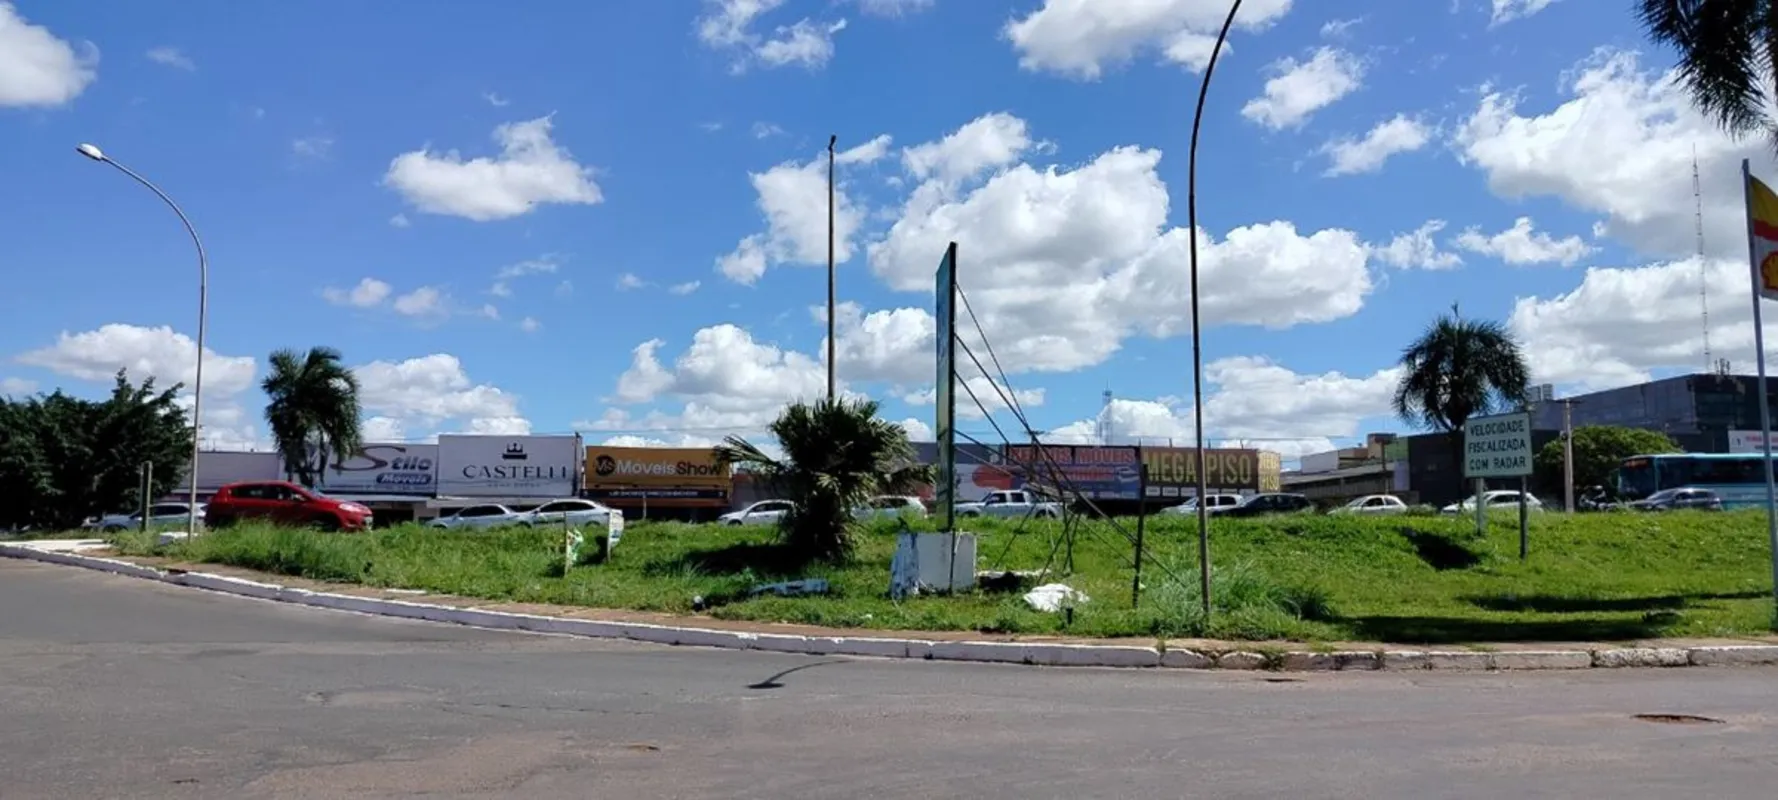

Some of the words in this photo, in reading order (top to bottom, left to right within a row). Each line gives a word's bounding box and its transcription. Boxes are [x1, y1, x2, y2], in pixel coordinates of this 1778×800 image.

[1470, 420, 1525, 437] VELOCIDADE
[1468, 438, 1527, 453] FISCALIZADA
[1142, 452, 1198, 484] MEGA
[1204, 453, 1253, 485] PISO
[1469, 458, 1489, 471] COM
[1493, 455, 1527, 469] RADAR
[462, 464, 568, 479] CASTELLI
